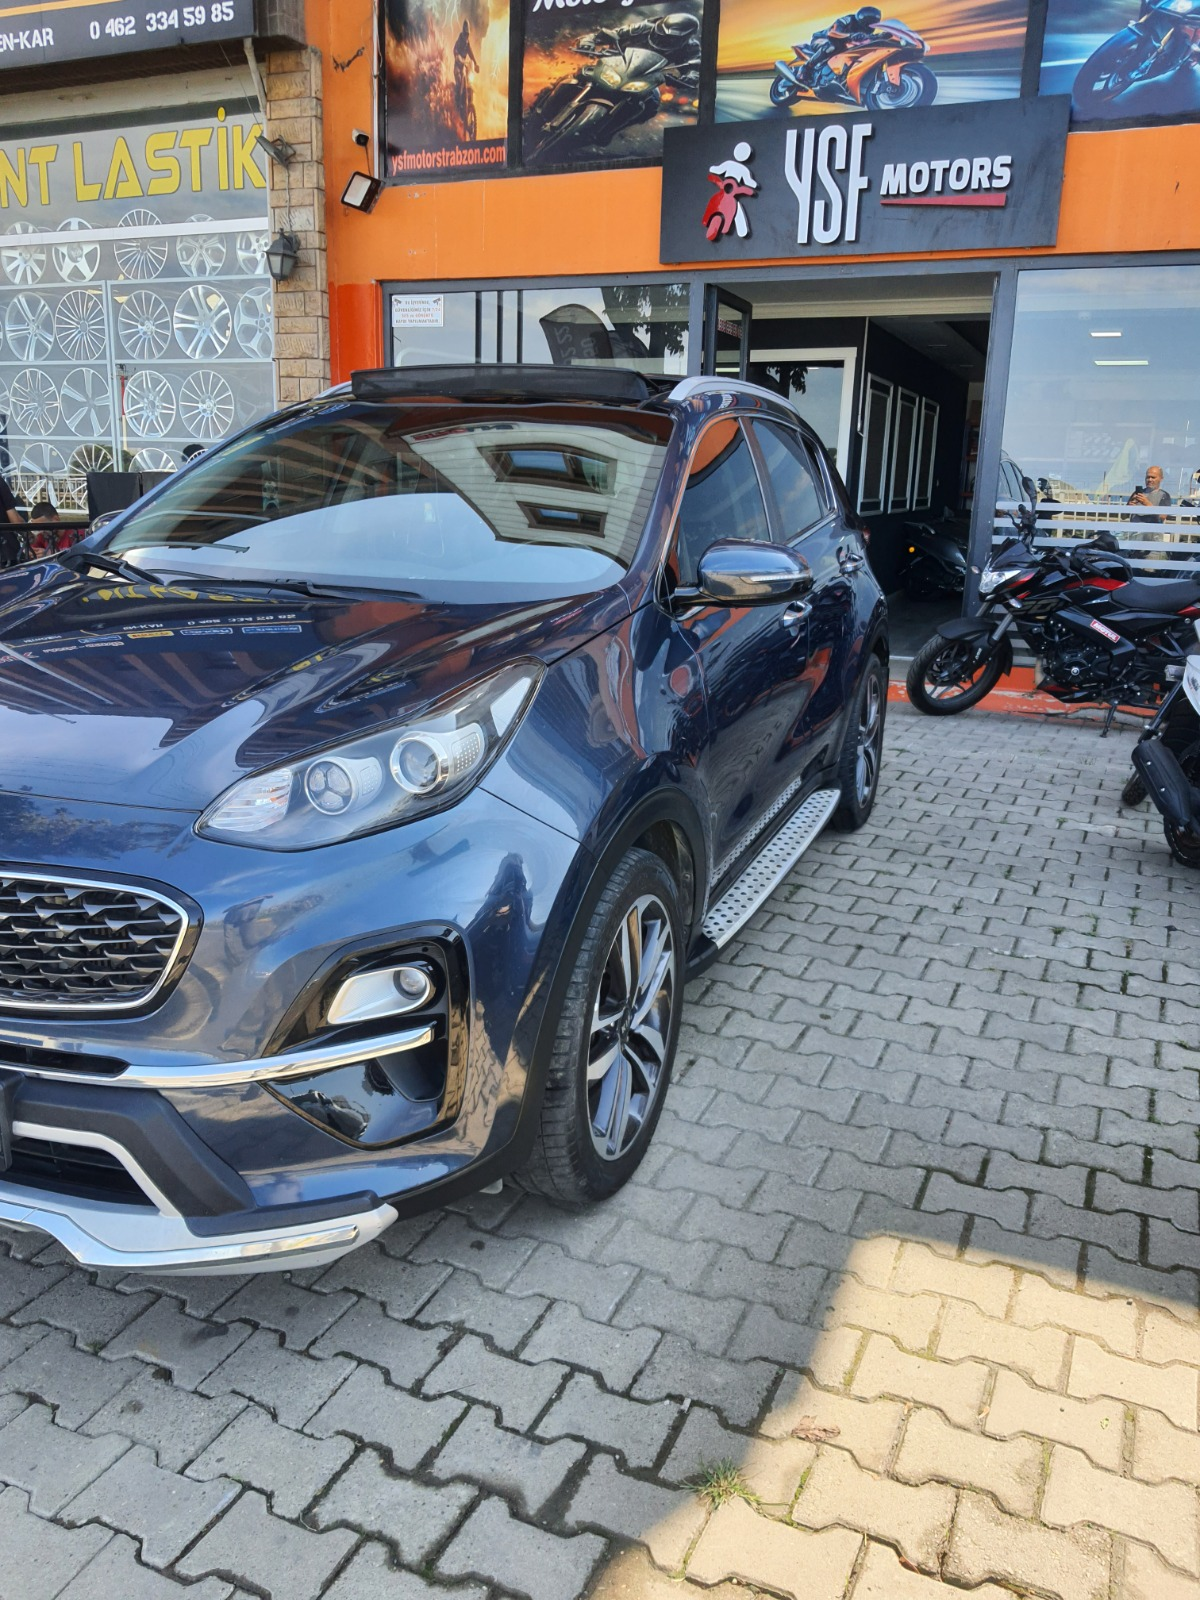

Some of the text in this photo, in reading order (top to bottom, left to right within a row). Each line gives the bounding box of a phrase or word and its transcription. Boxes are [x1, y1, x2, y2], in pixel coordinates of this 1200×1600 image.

[89, 21, 100, 40] 0
[105, 16, 136, 37] 462
[145, 9, 179, 32] 334
[183, 6, 206, 27] 59
[211, 1, 235, 23] 85
[73, 106, 267, 203] LASTİK
[391, 145, 506, 176] ysfmotorstrabzon.com
[784, 123, 1013, 244] YSF MOTORS
[1092, 621, 1118, 642] MOTUL
